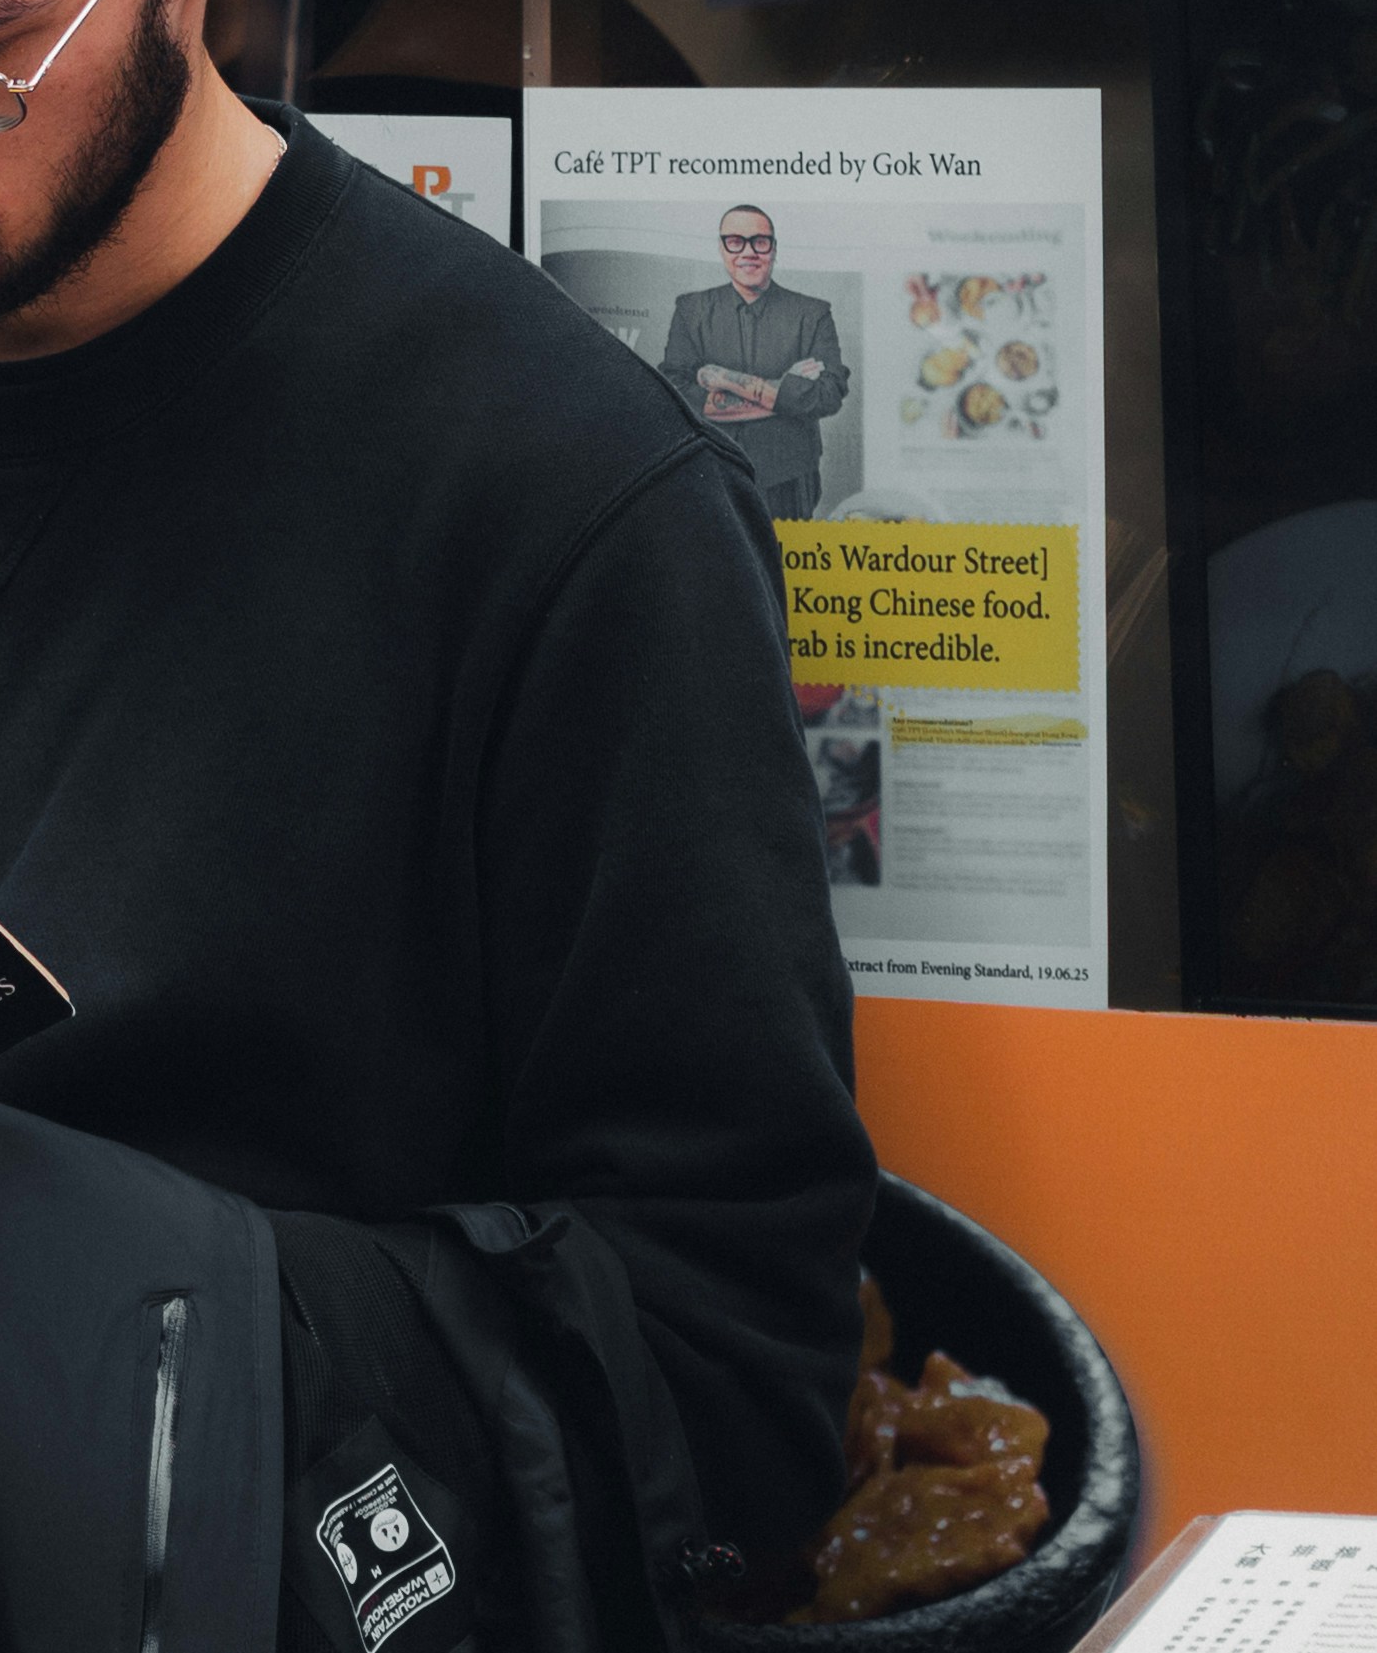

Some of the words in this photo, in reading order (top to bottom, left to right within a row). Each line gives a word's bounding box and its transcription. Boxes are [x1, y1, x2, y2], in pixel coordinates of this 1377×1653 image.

[554, 150, 605, 175] Café
[611, 152, 662, 175] TPT
[669, 151, 832, 176] recommended
[839, 152, 867, 183] by
[873, 152, 923, 176] Gok
[930, 153, 982, 176] Wan
[839, 544, 957, 573] Wardour
[964, 546, 1048, 581] Street]
[793, 586, 862, 623] Kong
[869, 588, 975, 618] Chinese
[983, 590, 1050, 619] food.
[788, 630, 828, 658] rab
[835, 633, 856, 659] is
[863, 632, 1000, 662] incredible.
[887, 959, 917, 974] from
[921, 961, 971, 980] Evening
[974, 963, 1033, 980] Standard,
[1038, 966, 1089, 982] 19.06.25
[370, 1564, 383, 1580] M
[370, 1586, 431, 1643] MOUNTAIN
